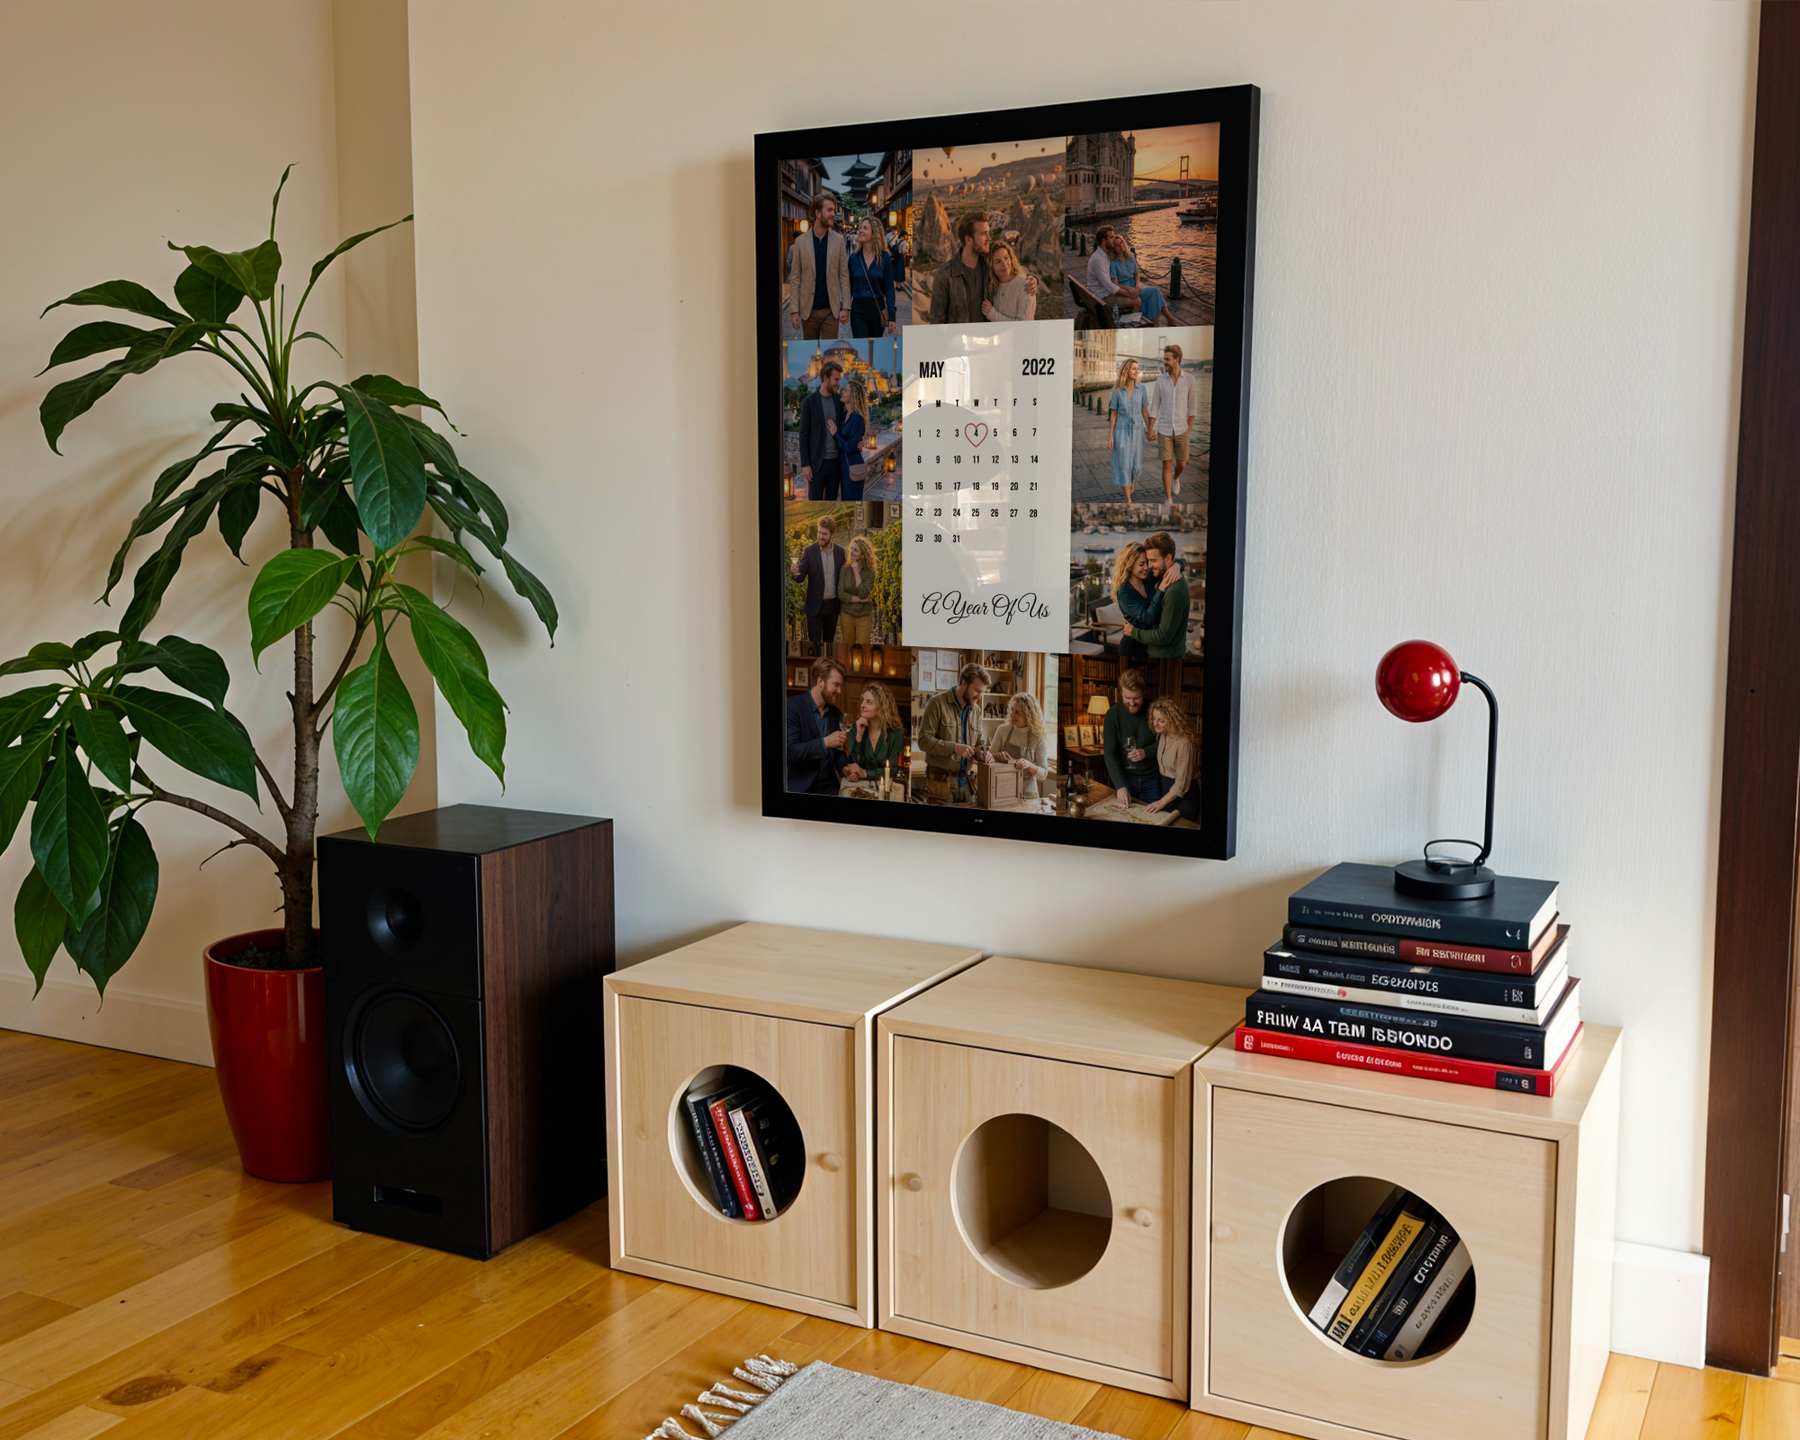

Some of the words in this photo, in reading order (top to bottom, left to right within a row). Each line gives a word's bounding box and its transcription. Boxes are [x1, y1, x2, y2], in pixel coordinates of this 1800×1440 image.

[919, 361, 945, 379] MAY
[1021, 357, 1055, 376] 2022
[917, 399, 922, 409] S
[935, 399, 942, 408] M
[955, 399, 960, 408] T
[973, 398, 980, 408] W
[993, 398, 999, 407] T
[1013, 397, 1018, 407] F
[1032, 397, 1038, 407] S
[918, 428, 922, 438] 1
[935, 428, 941, 438] 2
[954, 428, 960, 438] 3
[973, 428, 979, 438] 4
[993, 427, 998, 438] 5
[1012, 427, 1018, 438] 6
[1032, 427, 1037, 437] 7
[917, 454, 922, 465] 8
[935, 455, 941, 465] 9
[953, 454, 962, 465] 10
[972, 454, 980, 464] 11
[991, 454, 1000, 464] 12
[1010, 454, 1019, 464] 13
[1030, 454, 1039, 464] 14
[915, 481, 924, 491] 15
[934, 481, 943, 491] 16
[953, 481, 961, 491] 17
[972, 481, 981, 491] 18
[991, 481, 1000, 491] 19
[1009, 481, 1019, 491] 20
[1029, 481, 1038, 491] 21
[915, 507, 924, 517] 22
[933, 507, 943, 517] 23
[952, 507, 961, 517] 24
[971, 507, 980, 518] 25
[990, 508, 999, 518] 26
[1009, 508, 1019, 518] 27
[1029, 508, 1038, 518] 28
[915, 533, 924, 543] 29
[933, 533, 943, 543] 30
[952, 534, 961, 544] 31
[921, 591, 943, 615] A
[942, 590, 989, 625] Year
[991, 593, 1018, 625] Of
[1017, 592, 1051, 619] Us
